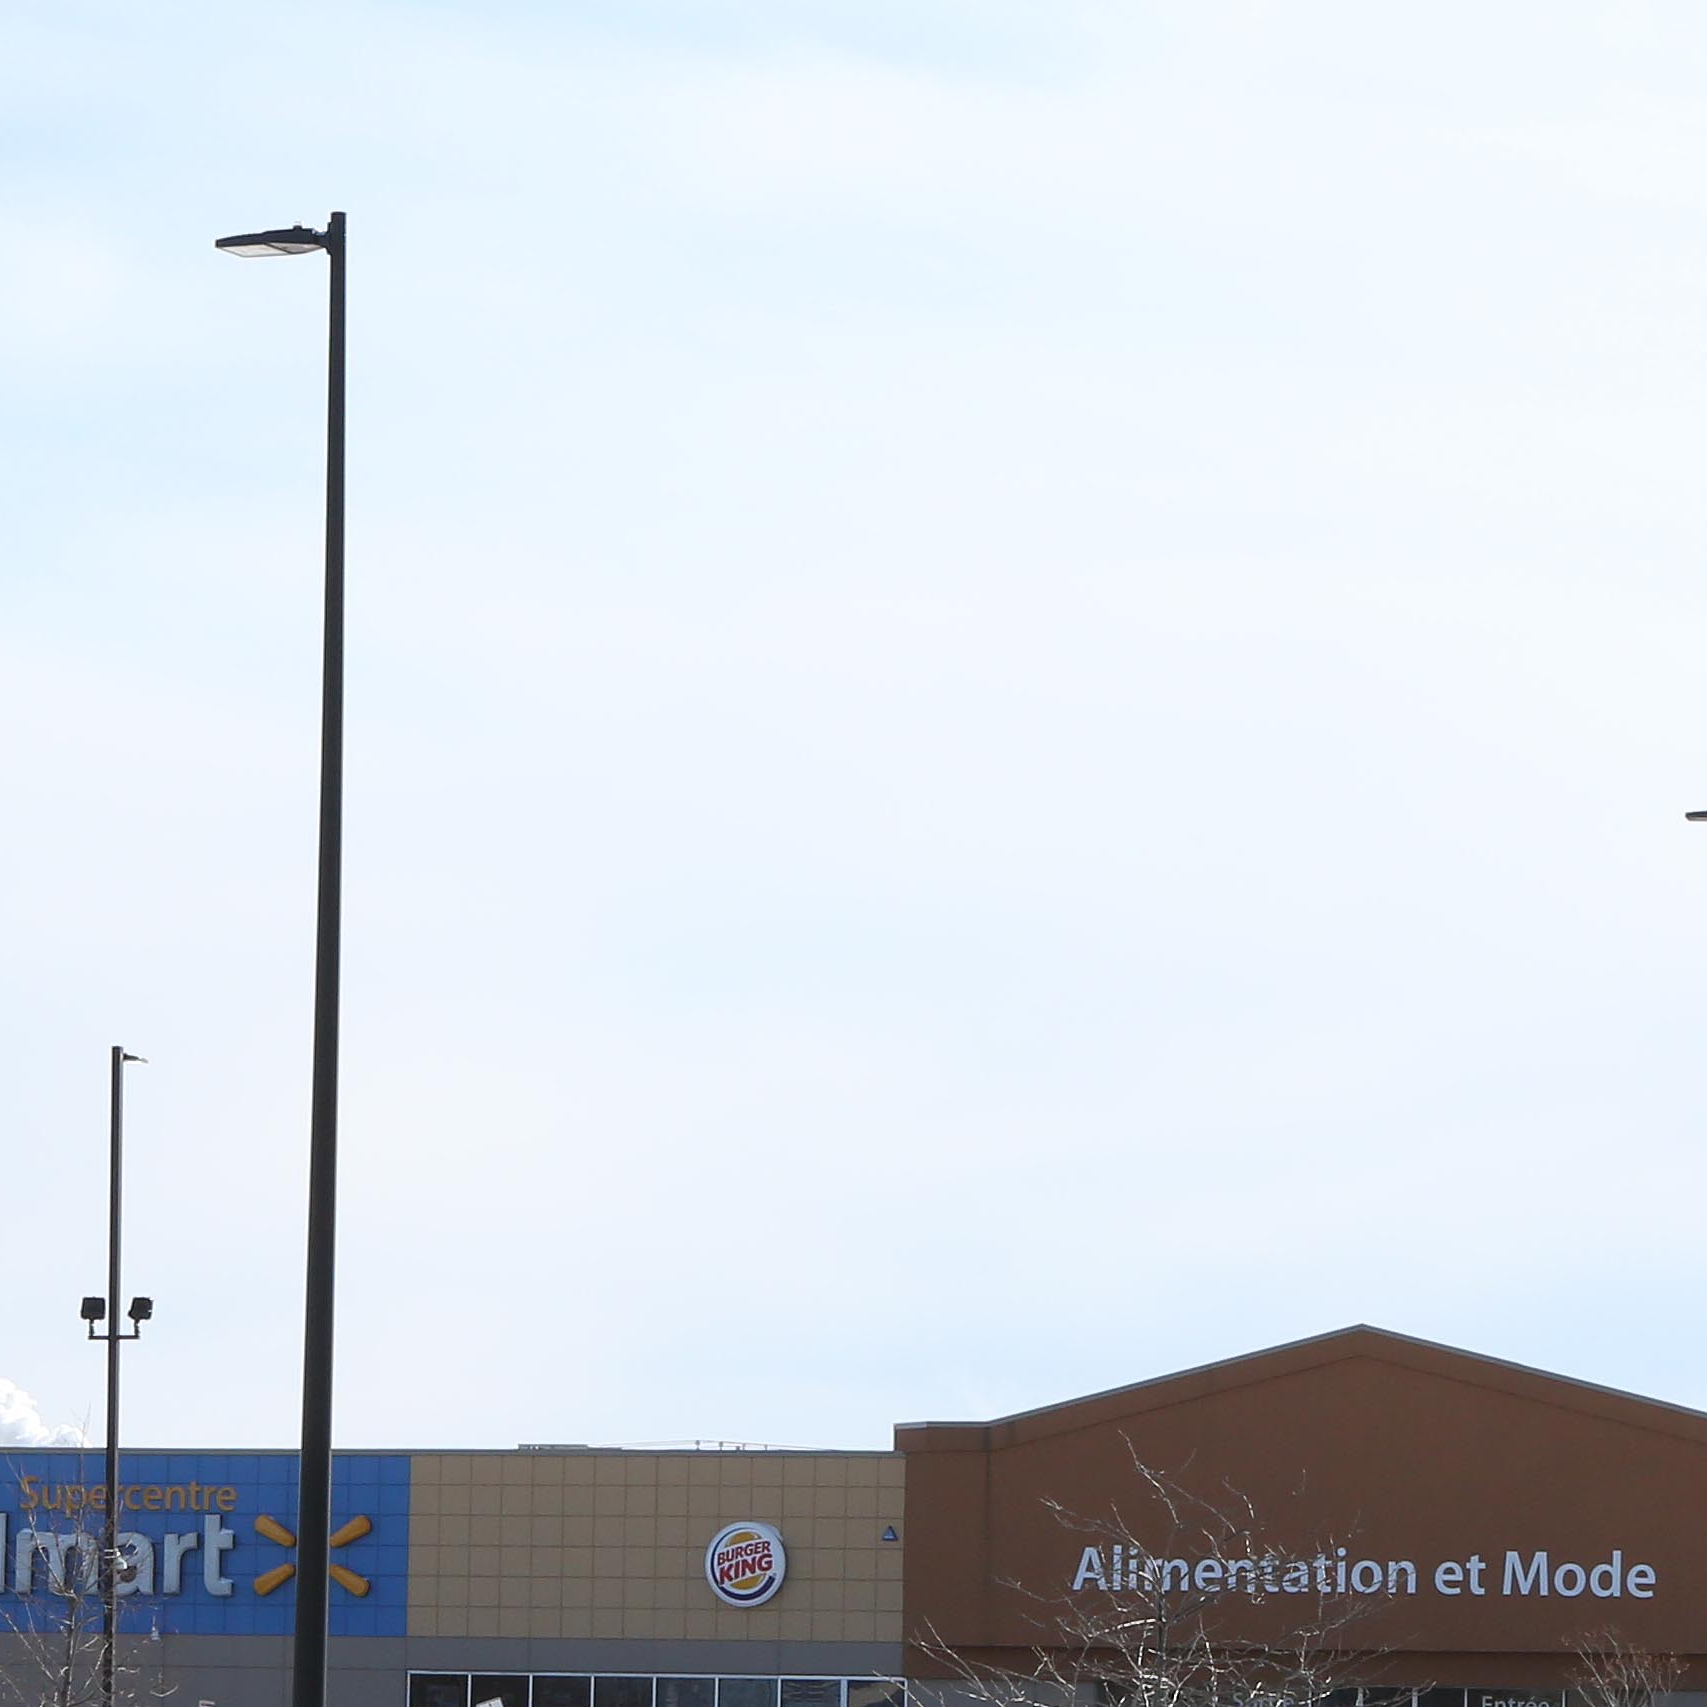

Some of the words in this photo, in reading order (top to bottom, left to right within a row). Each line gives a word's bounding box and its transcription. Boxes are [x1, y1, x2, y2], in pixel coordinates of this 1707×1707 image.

[19, 1475, 238, 1518] Supercentre
[717, 1541, 771, 1566] BURGER
[719, 1554, 773, 1585] KING
[1072, 1546, 1417, 1595] Alimentation
[1434, 1554, 1486, 1596] et
[1501, 1550, 1657, 1598] Mode
